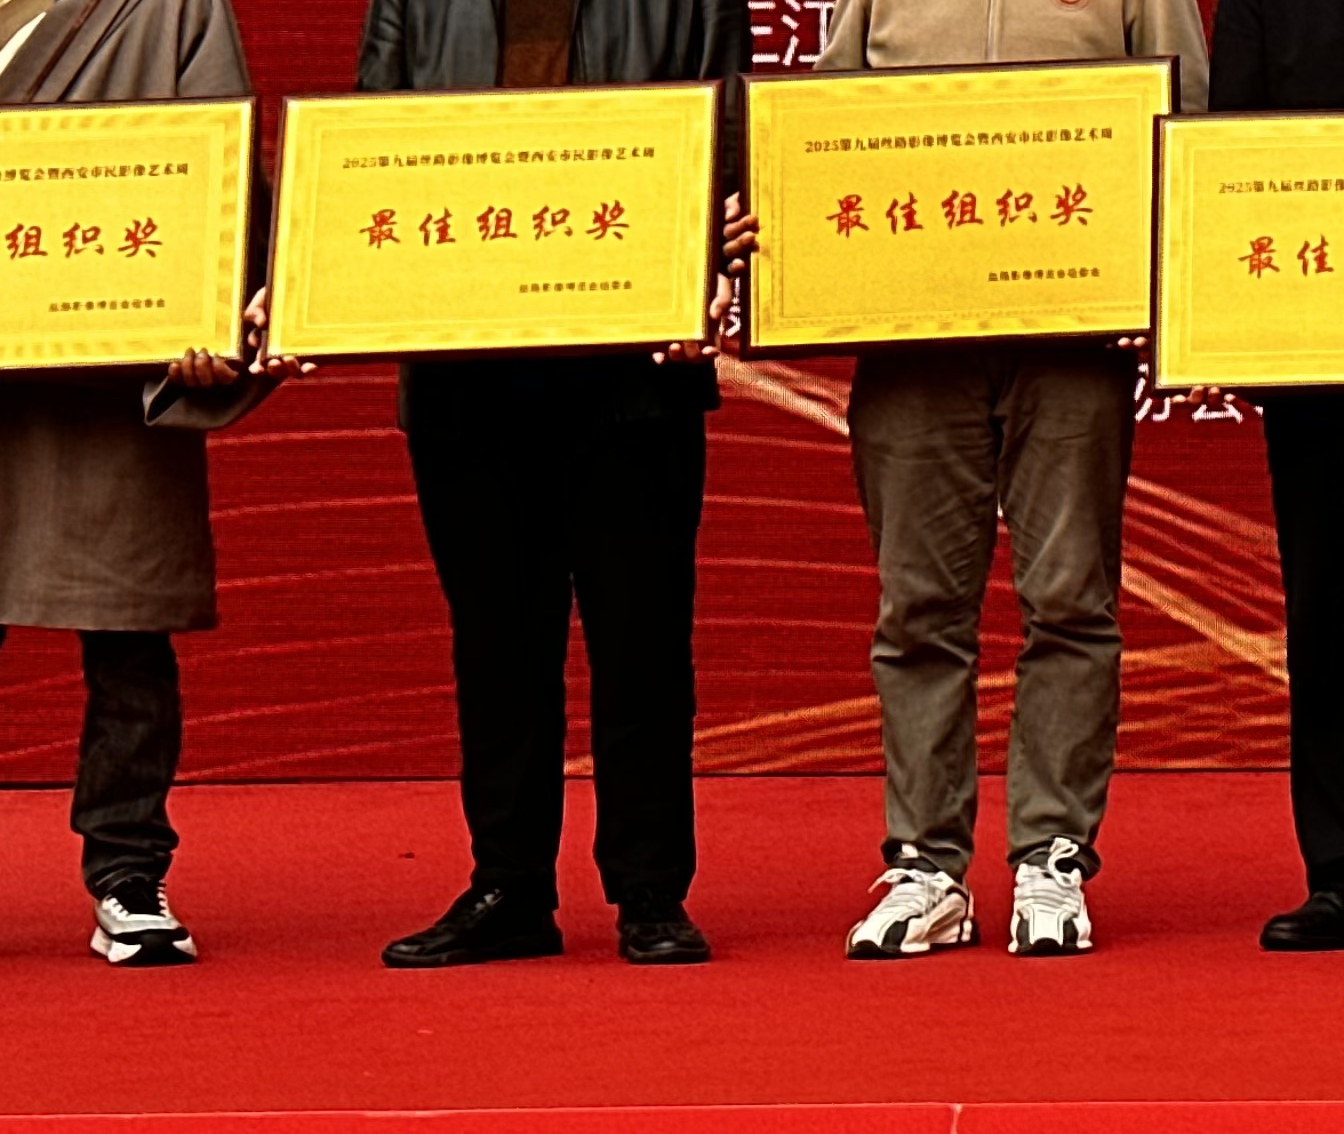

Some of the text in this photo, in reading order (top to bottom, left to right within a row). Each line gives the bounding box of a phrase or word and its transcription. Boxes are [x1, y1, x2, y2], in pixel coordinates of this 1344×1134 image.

[0, 163, 188, 181] 博览会暨西安市民影像艺术周
[359, 199, 630, 249] 最佳组织奖
[826, 183, 1093, 238] 最佳组织奖
[5, 217, 163, 260] 组织奖
